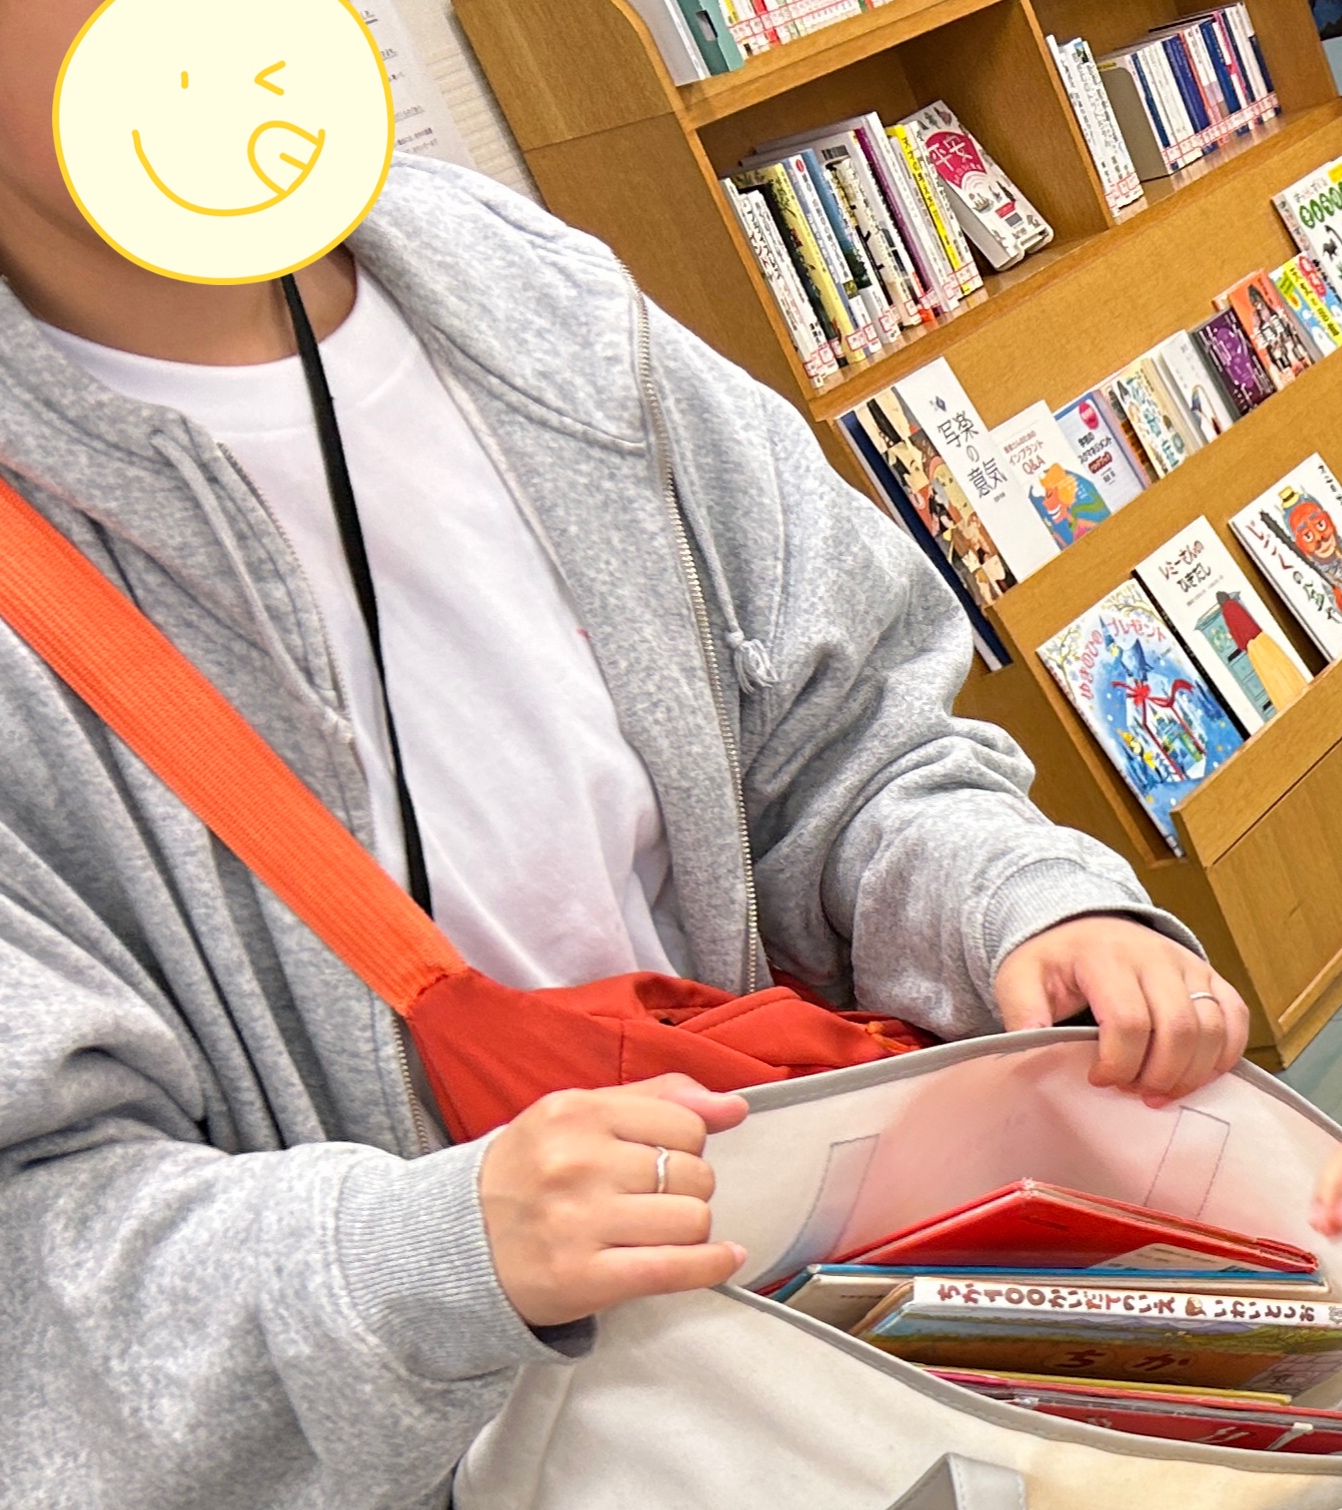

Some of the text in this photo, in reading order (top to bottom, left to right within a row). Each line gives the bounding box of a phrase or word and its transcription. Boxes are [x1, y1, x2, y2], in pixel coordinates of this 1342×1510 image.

[926, 130, 974, 177] 平安
[934, 406, 982, 453] 写楽
[962, 441, 983, 464] の
[1005, 437, 1047, 468] インプラント
[1019, 452, 1048, 477] Q&A
[965, 456, 1010, 499] 意気
[1155, 536, 1207, 583] レミーさんの
[1174, 558, 1215, 595] ひきだし
[1106, 616, 1168, 643] プレゼント
